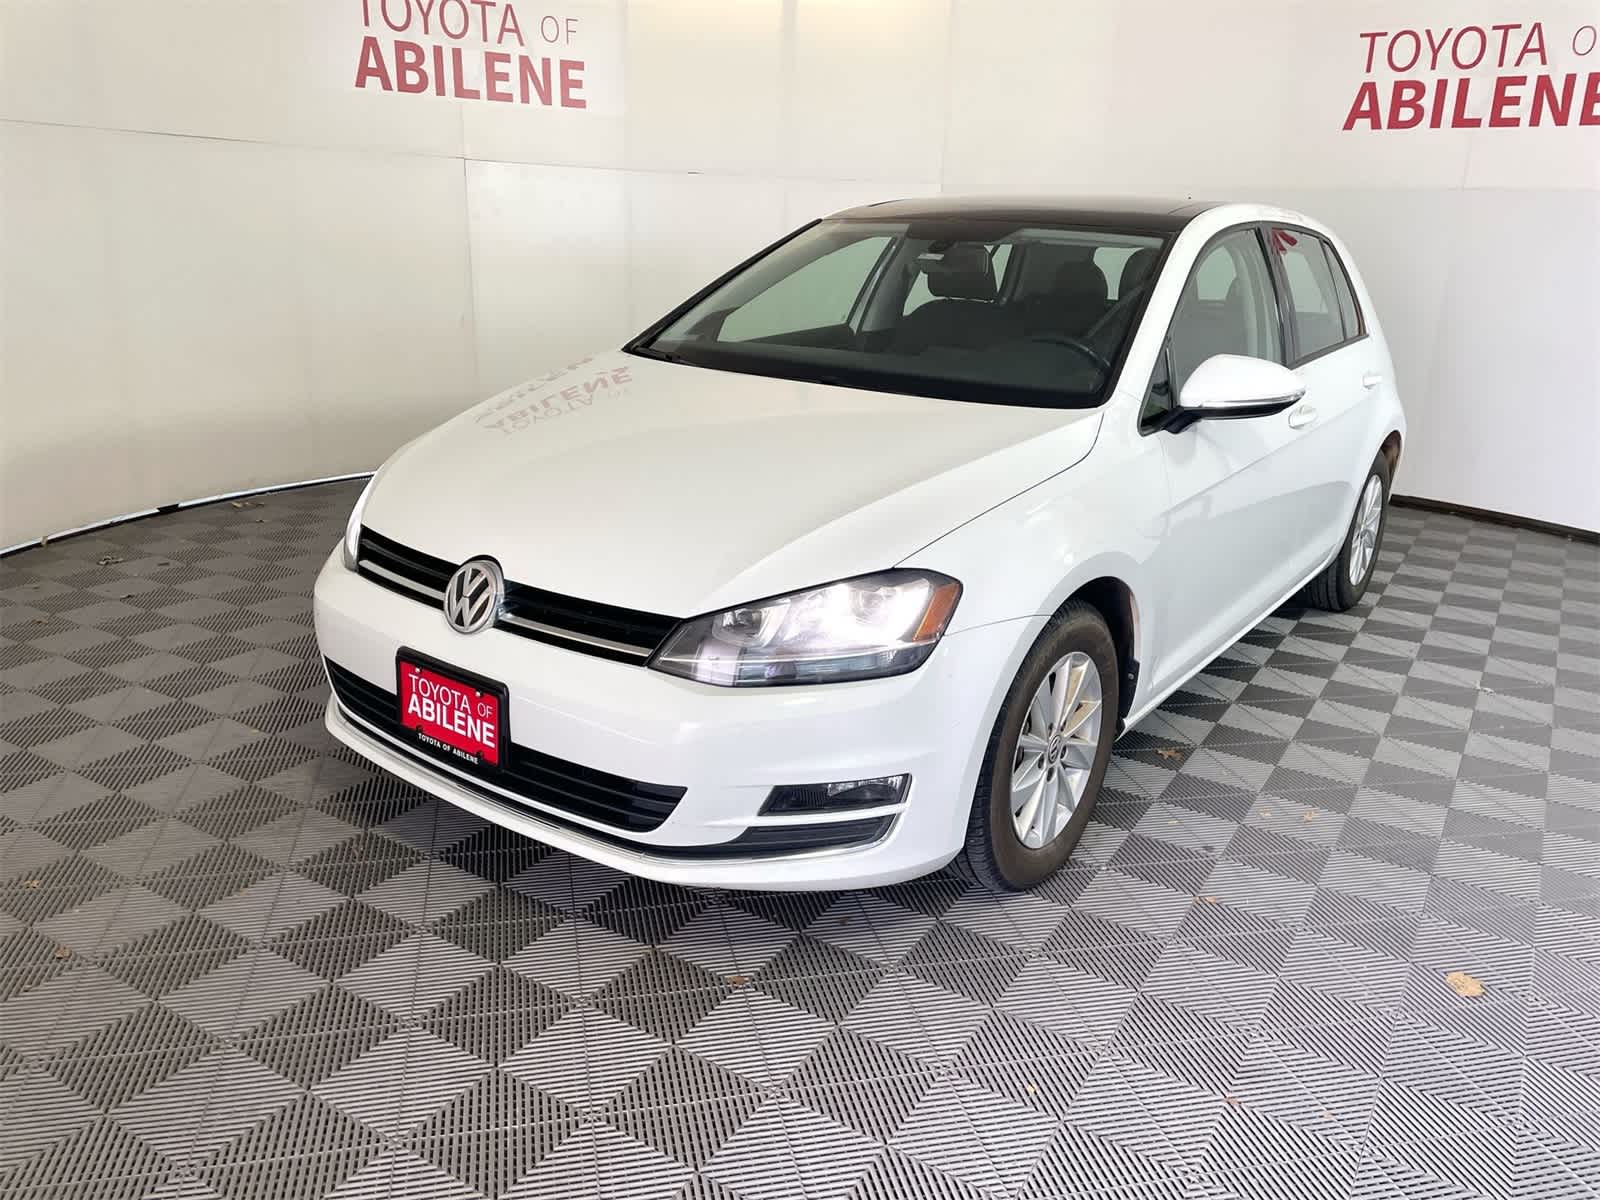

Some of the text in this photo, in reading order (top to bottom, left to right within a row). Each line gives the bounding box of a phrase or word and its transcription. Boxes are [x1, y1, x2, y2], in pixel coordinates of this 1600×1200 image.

[540, 15, 579, 45] OF
[1359, 22, 1548, 74] TOYOTA
[354, 35, 588, 109] ABILENE
[408, 673, 494, 719] TOYOTA OF
[408, 693, 496, 749] ABILENE
[418, 732, 479, 765] TOYOTA OF ABILENE
